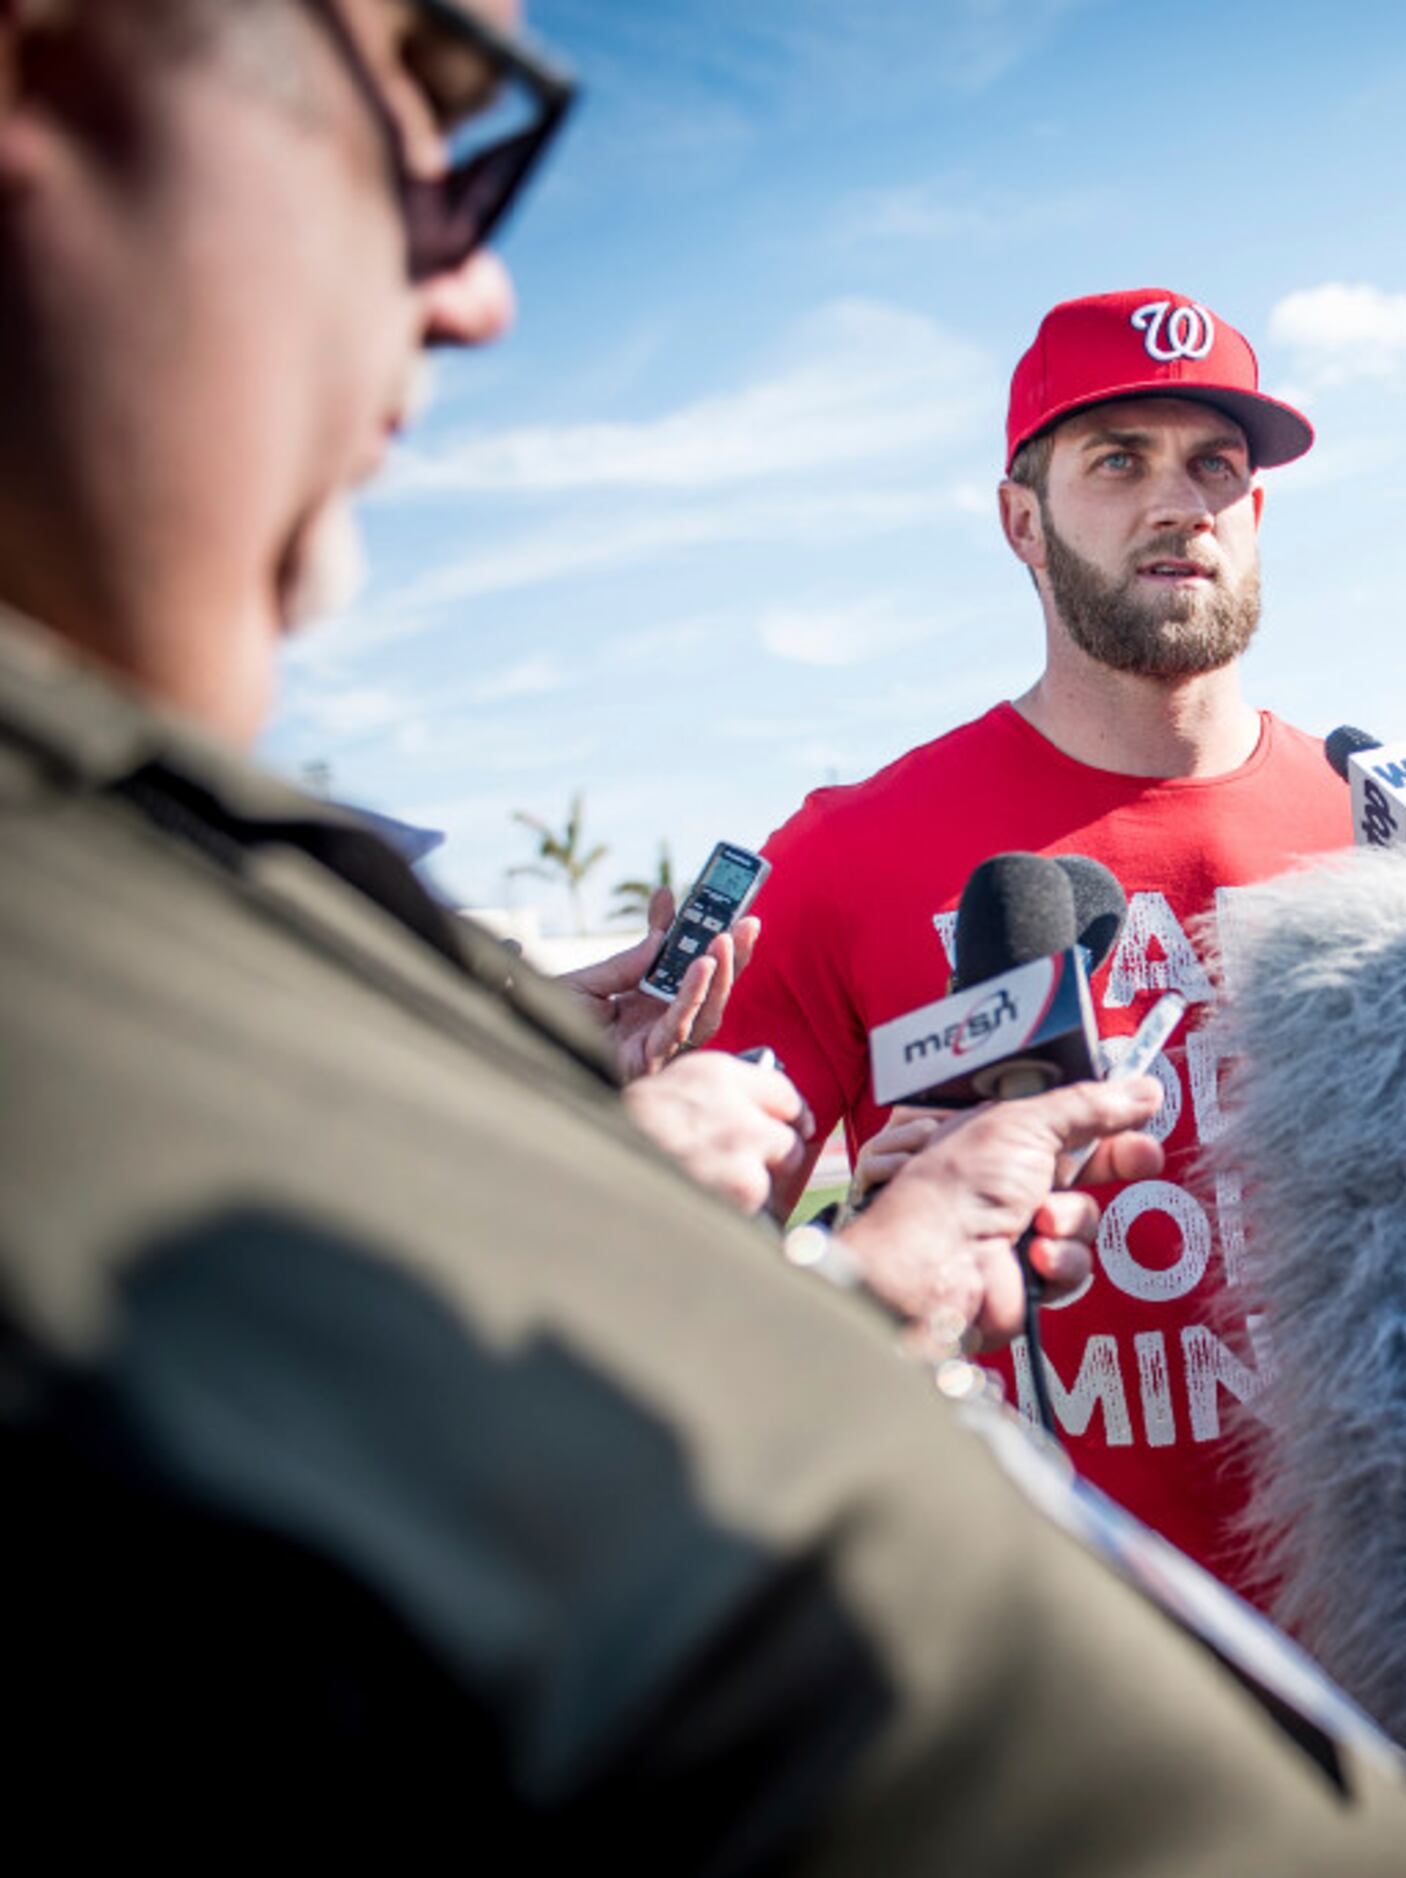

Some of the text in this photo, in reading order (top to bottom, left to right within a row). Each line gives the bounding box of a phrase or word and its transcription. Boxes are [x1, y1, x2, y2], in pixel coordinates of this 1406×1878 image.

[1130, 301, 1214, 361] W
[1361, 779, 1398, 847] top
[1009, 1314, 1280, 1447] MIN
